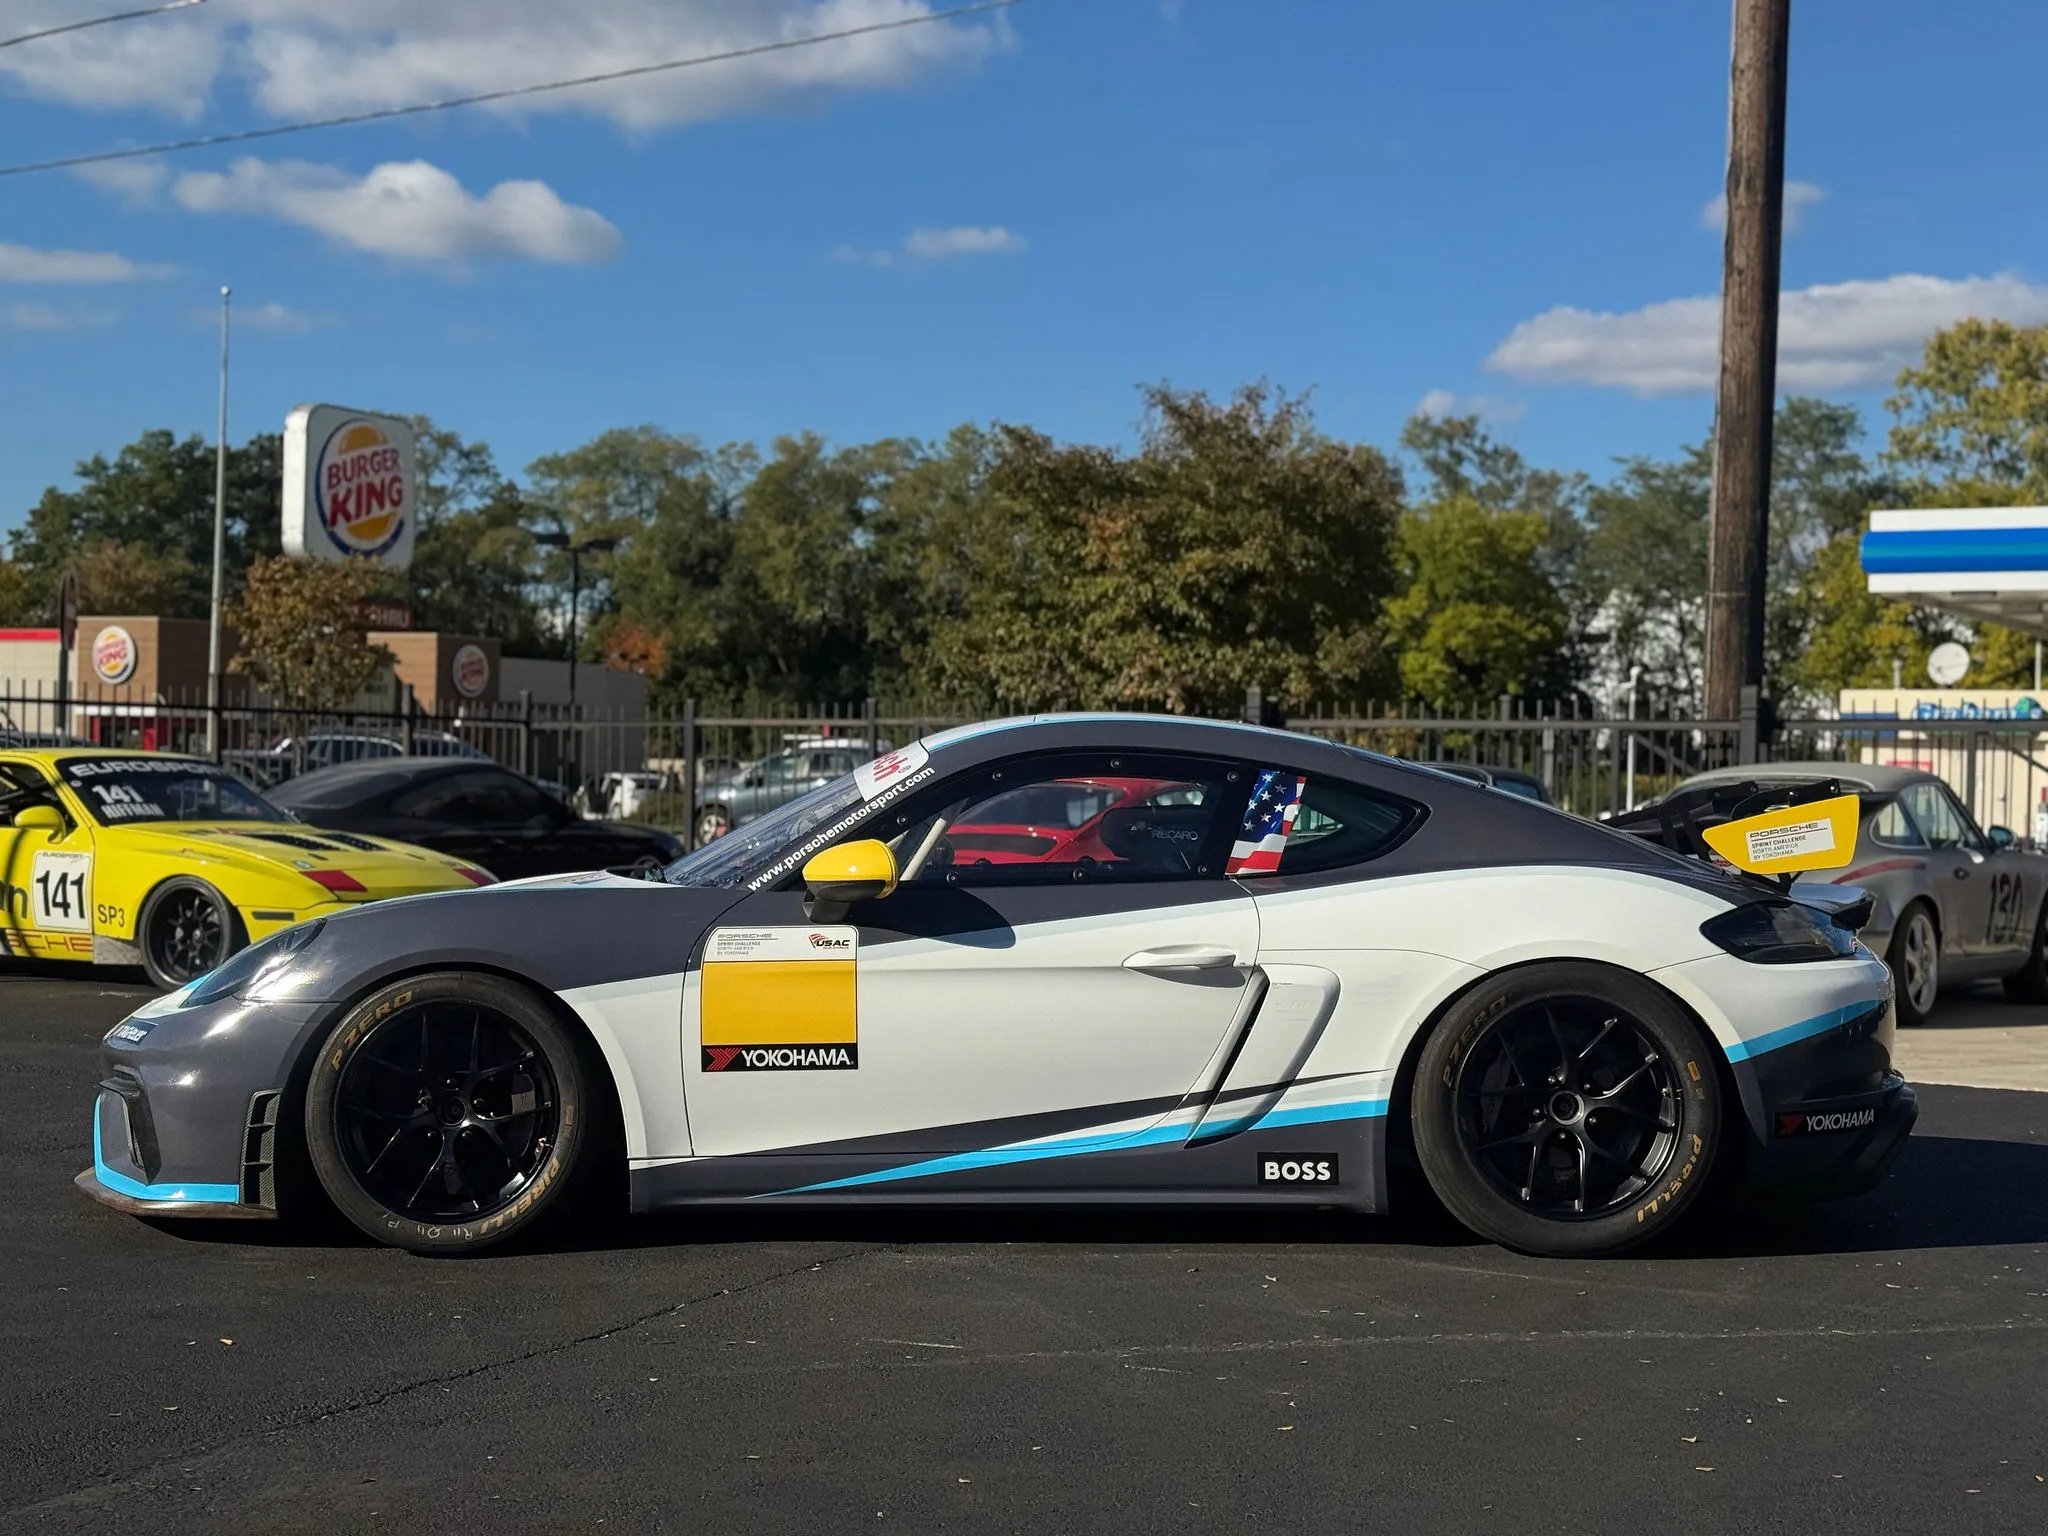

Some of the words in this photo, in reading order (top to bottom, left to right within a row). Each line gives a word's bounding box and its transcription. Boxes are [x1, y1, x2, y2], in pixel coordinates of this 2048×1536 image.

[327, 448, 400, 490] BURGER
[328, 474, 404, 529] KING
[92, 785, 144, 804] 141
[747, 767, 936, 892] www.porschemotorsport.com
[1152, 830, 1199, 841] RECARO
[1750, 822, 1819, 839] PORSCHE
[1751, 840, 1773, 849] SPRINT
[1773, 835, 1807, 846] CHALLENGE
[1752, 847, 1773, 855] NORTH
[1773, 842, 1799, 852] AMERICA
[42, 851, 84, 859] EUROSPORT
[35, 869, 86, 919] 141
[97, 903, 125, 928] SP3
[816, 939, 850, 947] USAC
[331, 1049, 343, 1071] P
[344, 991, 413, 1051] ZERO
[1450, 995, 1506, 1064] ZERO
[741, 1048, 851, 1067] YOKOHAMA
[1806, 1109, 1875, 1132] YOKOHAMA
[1264, 1161, 1331, 1181] BOSS
[480, 1157, 560, 1235] PIRELLI
